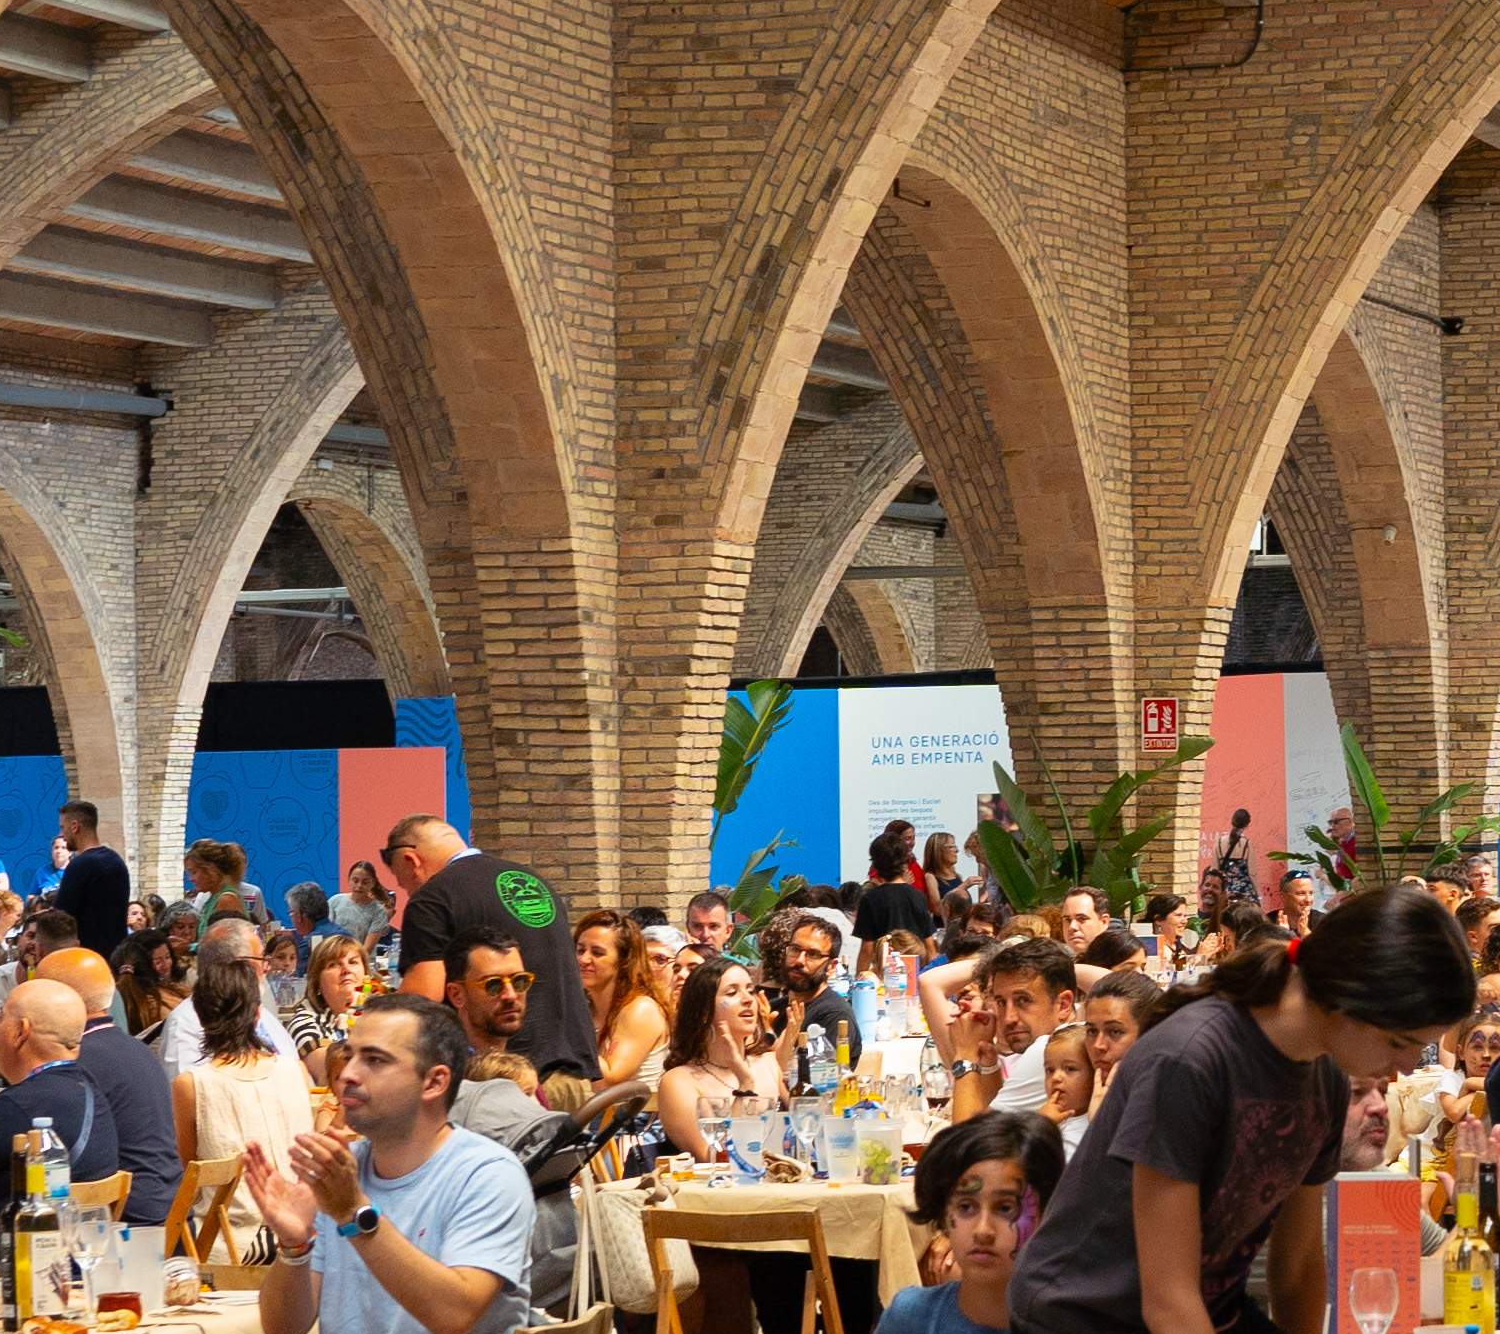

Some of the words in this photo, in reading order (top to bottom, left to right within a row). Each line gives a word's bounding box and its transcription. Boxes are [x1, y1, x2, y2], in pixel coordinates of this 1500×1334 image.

[871, 736, 904, 748] UNA
[909, 730, 999, 748] GENERACIÓ
[871, 753, 905, 765] AMB
[911, 751, 984, 765] EMPENTA
